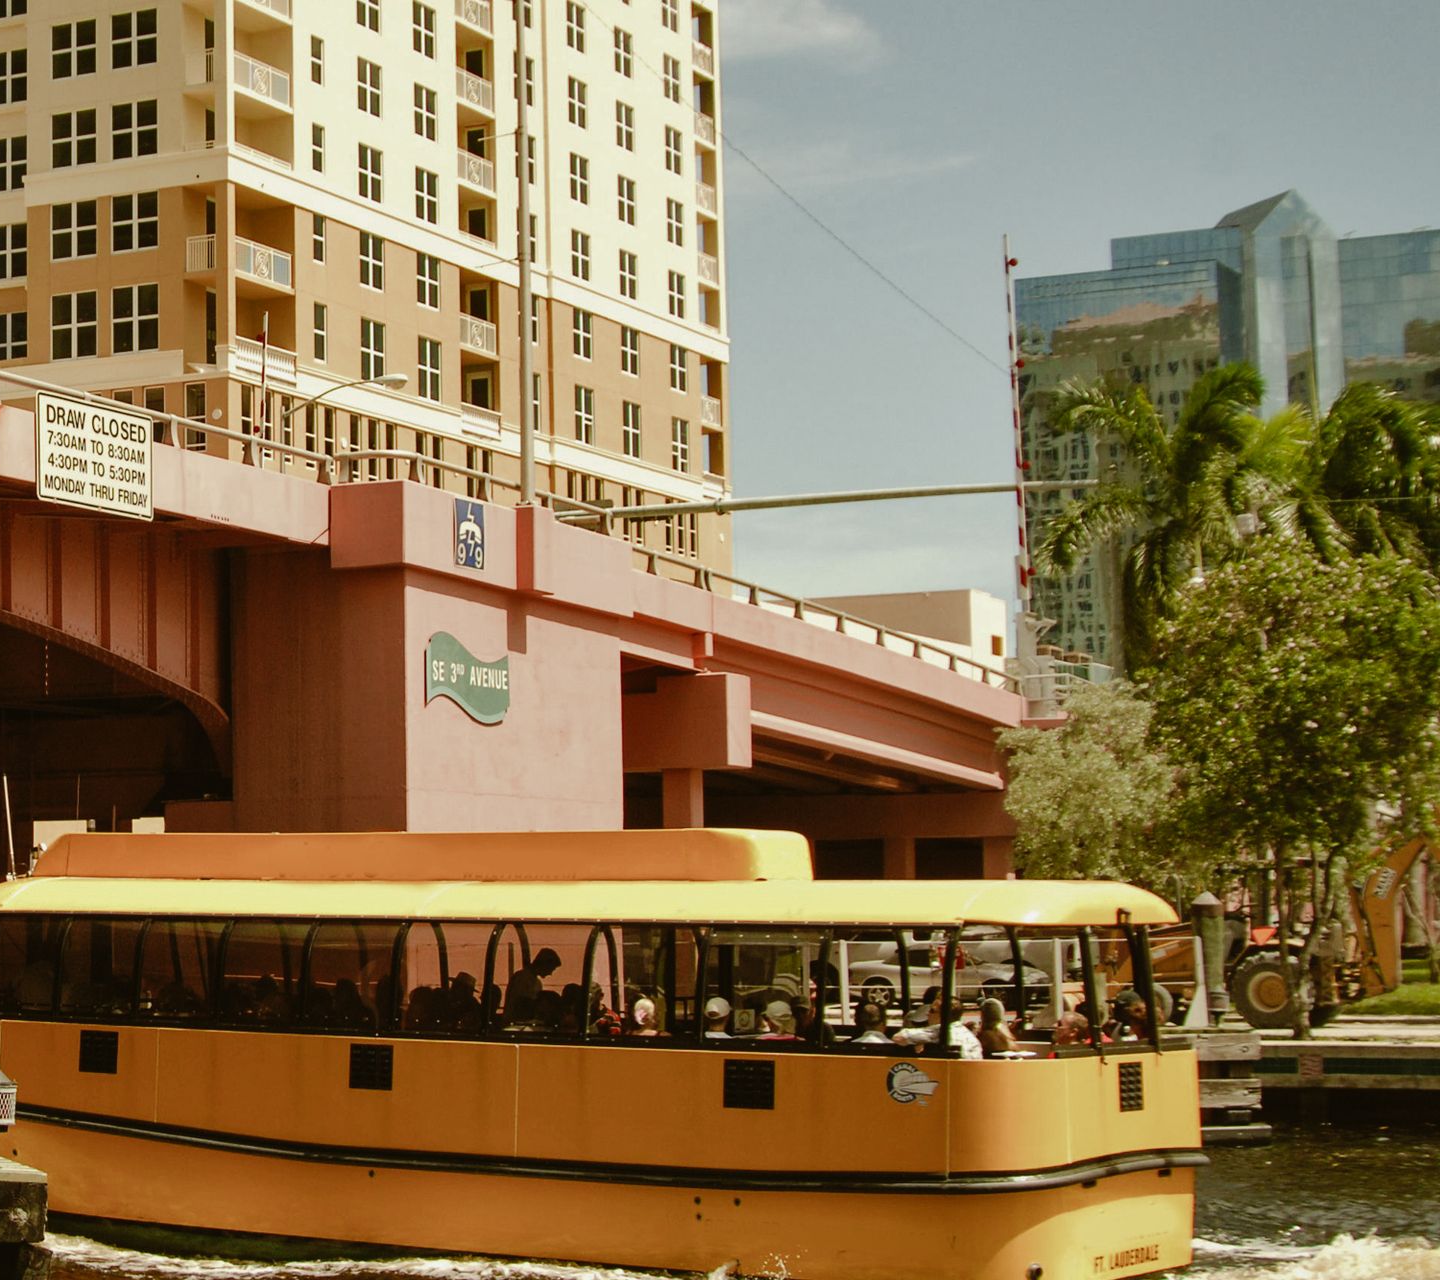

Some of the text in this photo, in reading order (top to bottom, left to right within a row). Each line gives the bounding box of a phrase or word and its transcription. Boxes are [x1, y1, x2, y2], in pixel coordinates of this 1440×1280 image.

[46, 404, 146, 444] DRAW CLOSED
[47, 430, 145, 465] 7:30AM TO 8:30AM
[48, 452, 146, 486] 4:30PM TO 5:30PM
[44, 474, 148, 508] MONDAY THRU FRIDAY
[432, 660, 508, 690] SE 3RD AVENUE
[1109, 1244, 1159, 1271] LAUDERDALE
